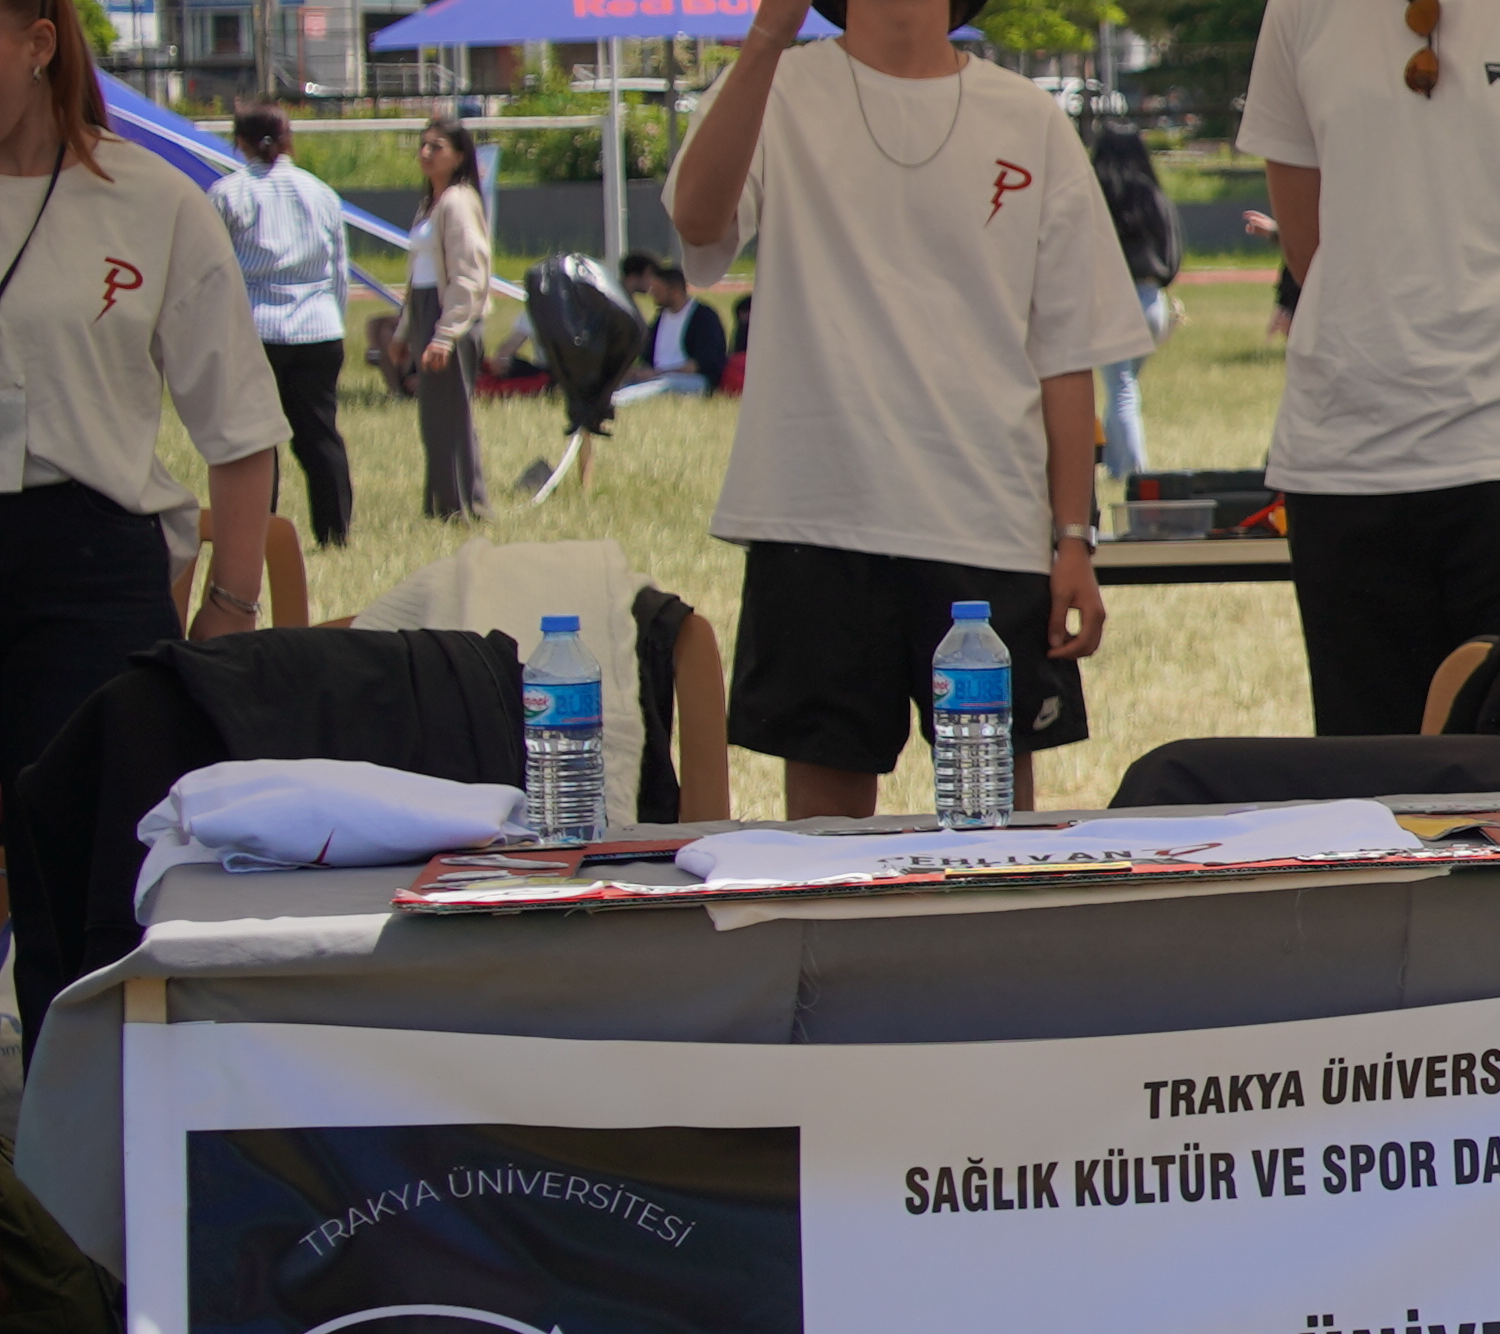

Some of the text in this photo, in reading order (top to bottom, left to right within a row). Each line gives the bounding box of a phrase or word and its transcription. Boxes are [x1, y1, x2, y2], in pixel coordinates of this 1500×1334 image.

[1143, 1068, 1307, 1121] TRAKYA
[299, 1163, 697, 1258] TRAKYA ÜNİVERSİTESİ
[904, 1155, 1060, 1216] SAĞLIK
[1073, 1143, 1239, 1207] KÜLTÜR
[1251, 1148, 1307, 1199] VE
[1322, 1137, 1439, 1195] SPOR
